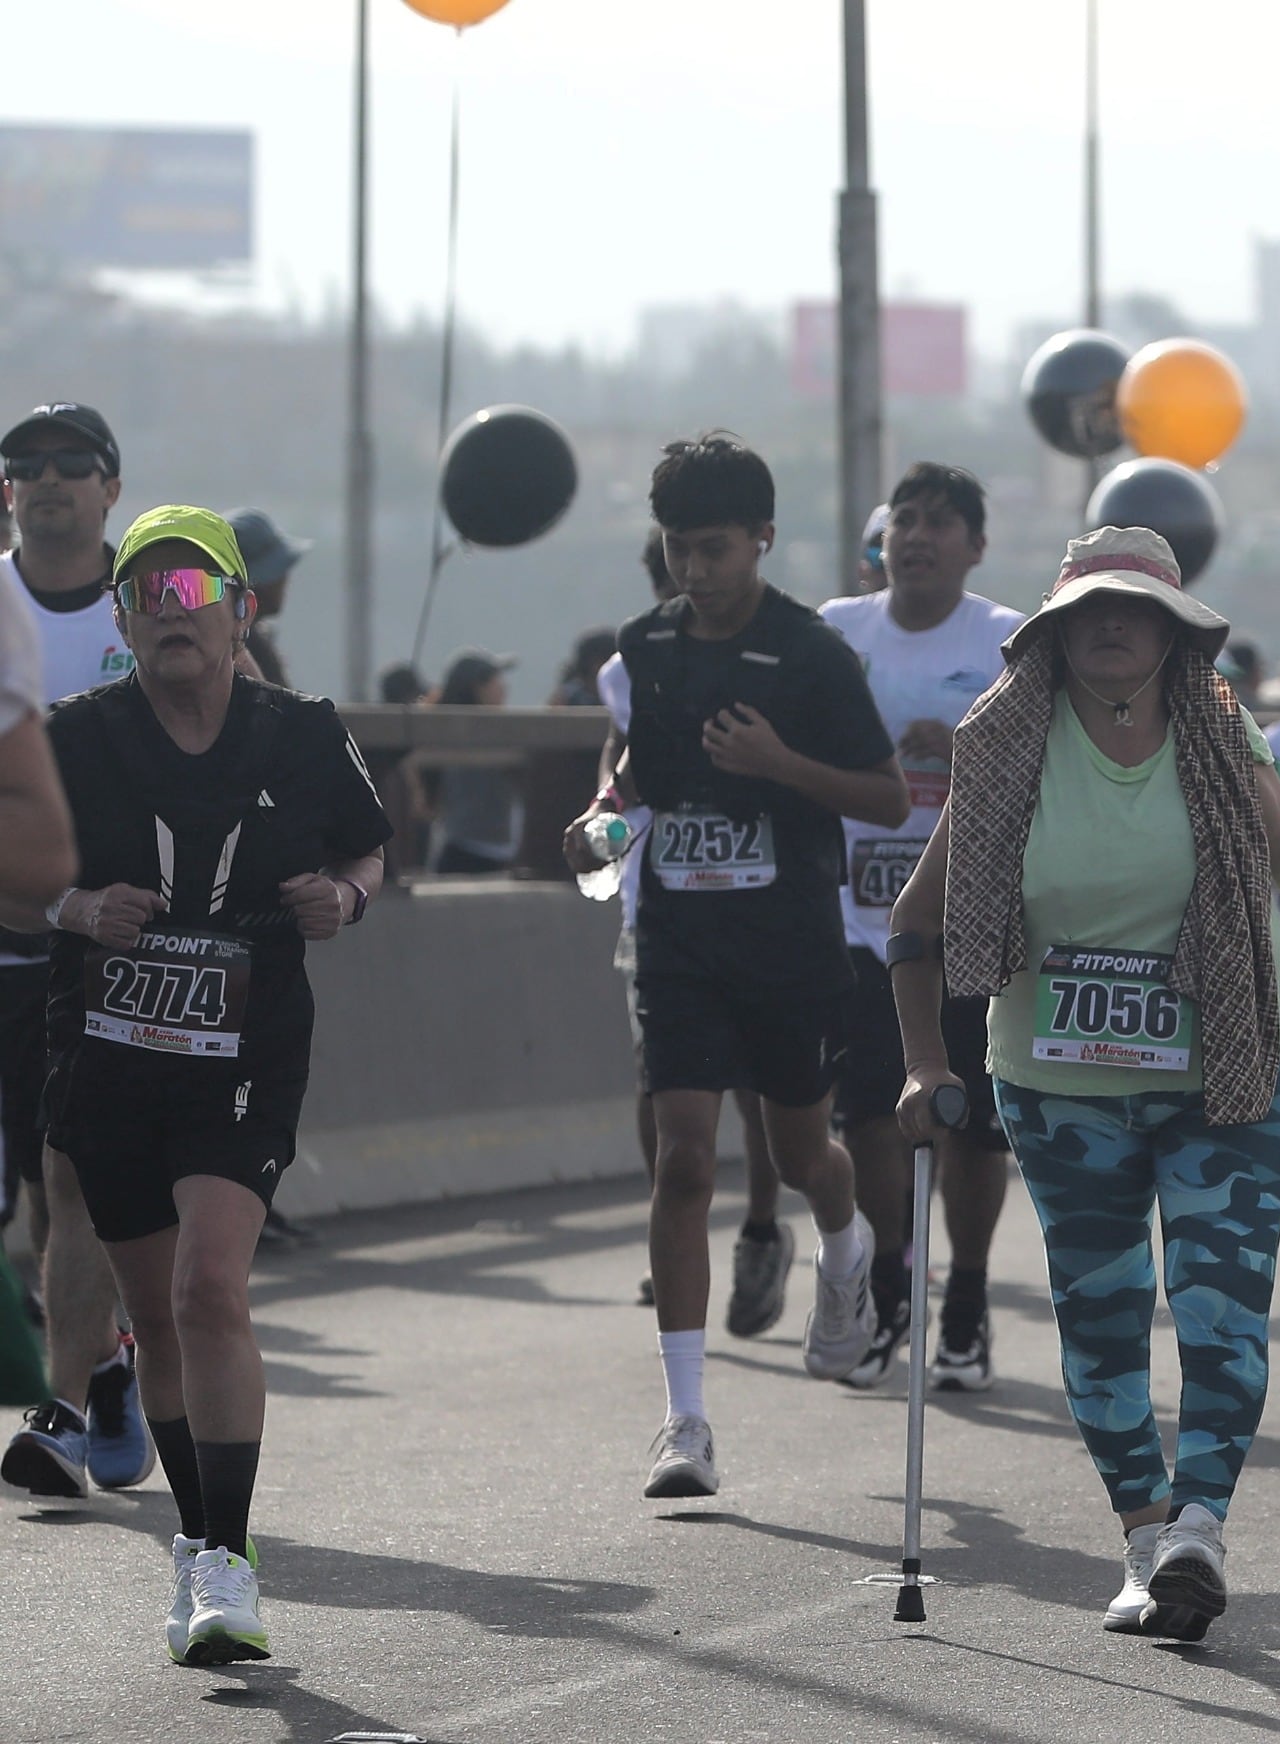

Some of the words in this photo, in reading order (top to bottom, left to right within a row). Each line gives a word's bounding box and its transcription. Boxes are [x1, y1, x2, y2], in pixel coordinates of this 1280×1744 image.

[659, 815, 763, 867] 2252
[103, 956, 226, 1026] 2774
[1072, 953, 1158, 974] FITPOINT
[1051, 978, 1181, 1042] 7056
